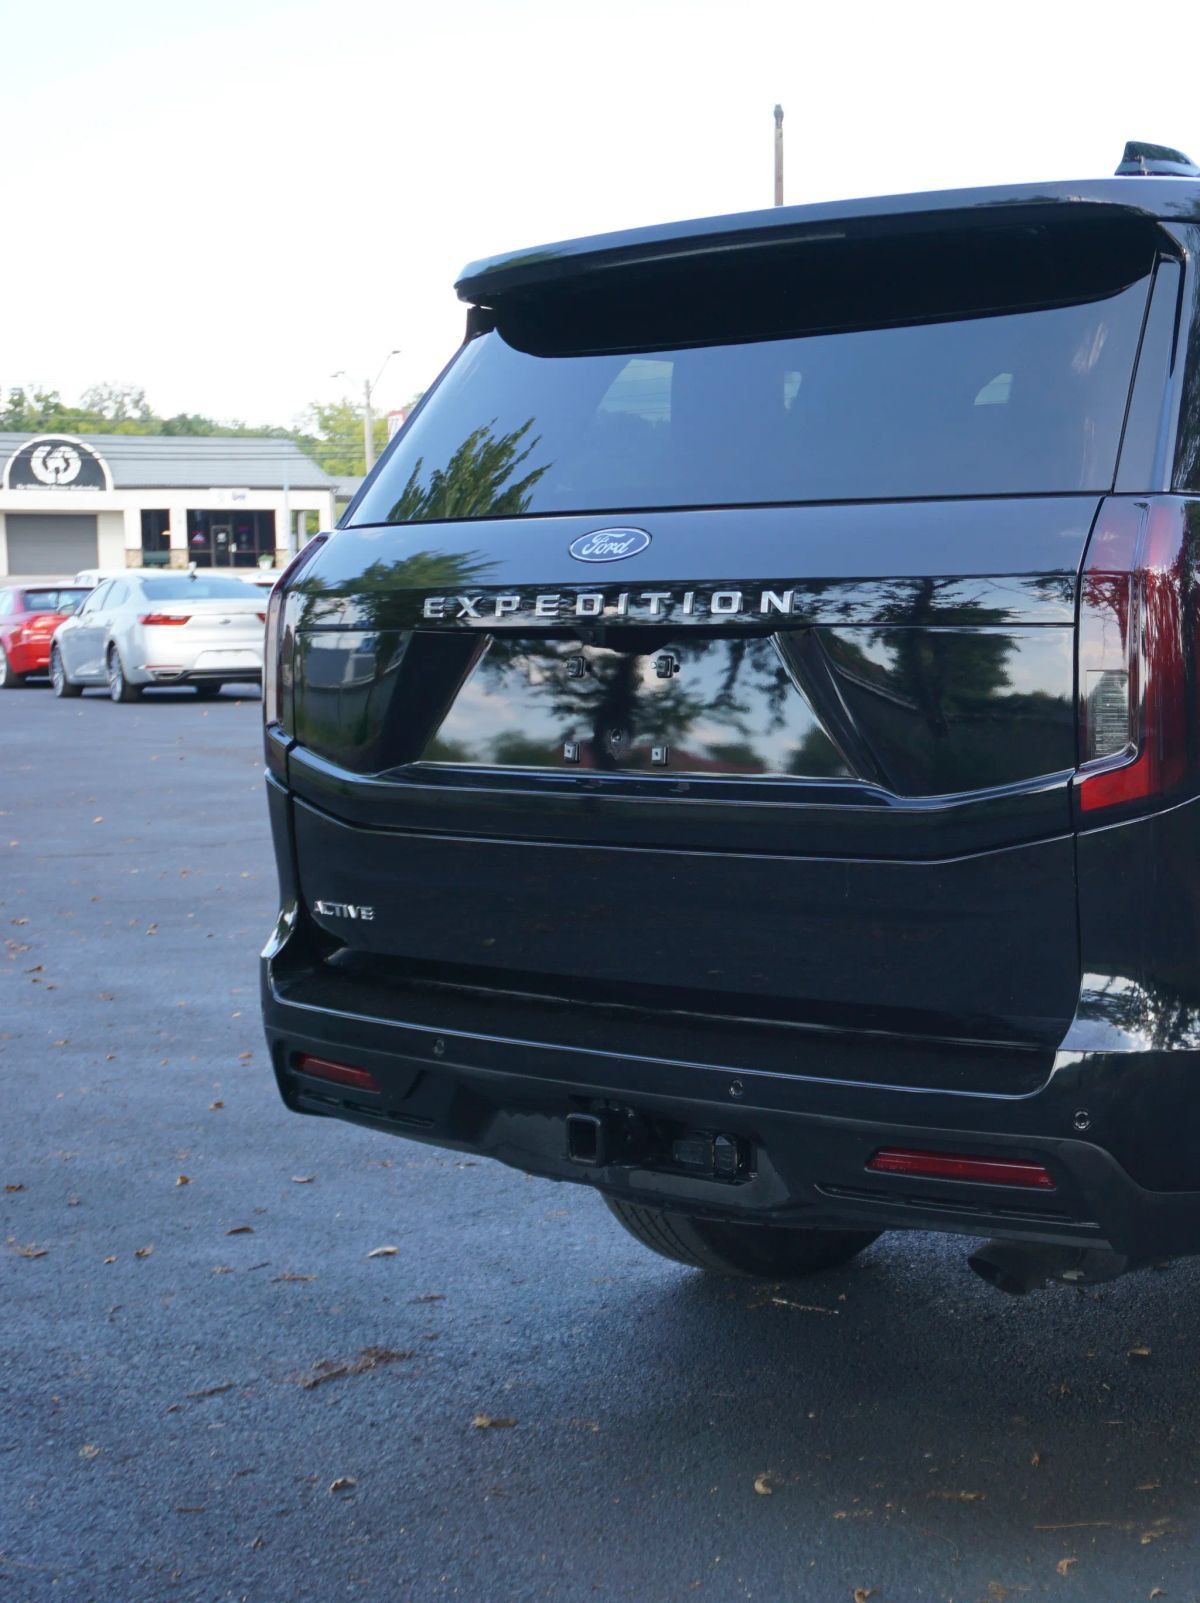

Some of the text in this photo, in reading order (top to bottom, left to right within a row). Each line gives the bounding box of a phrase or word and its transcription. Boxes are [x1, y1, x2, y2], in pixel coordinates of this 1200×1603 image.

[582, 533, 630, 555] Ford
[423, 590, 796, 619] EXPEDITION
[315, 901, 375, 920] ACTIVE
